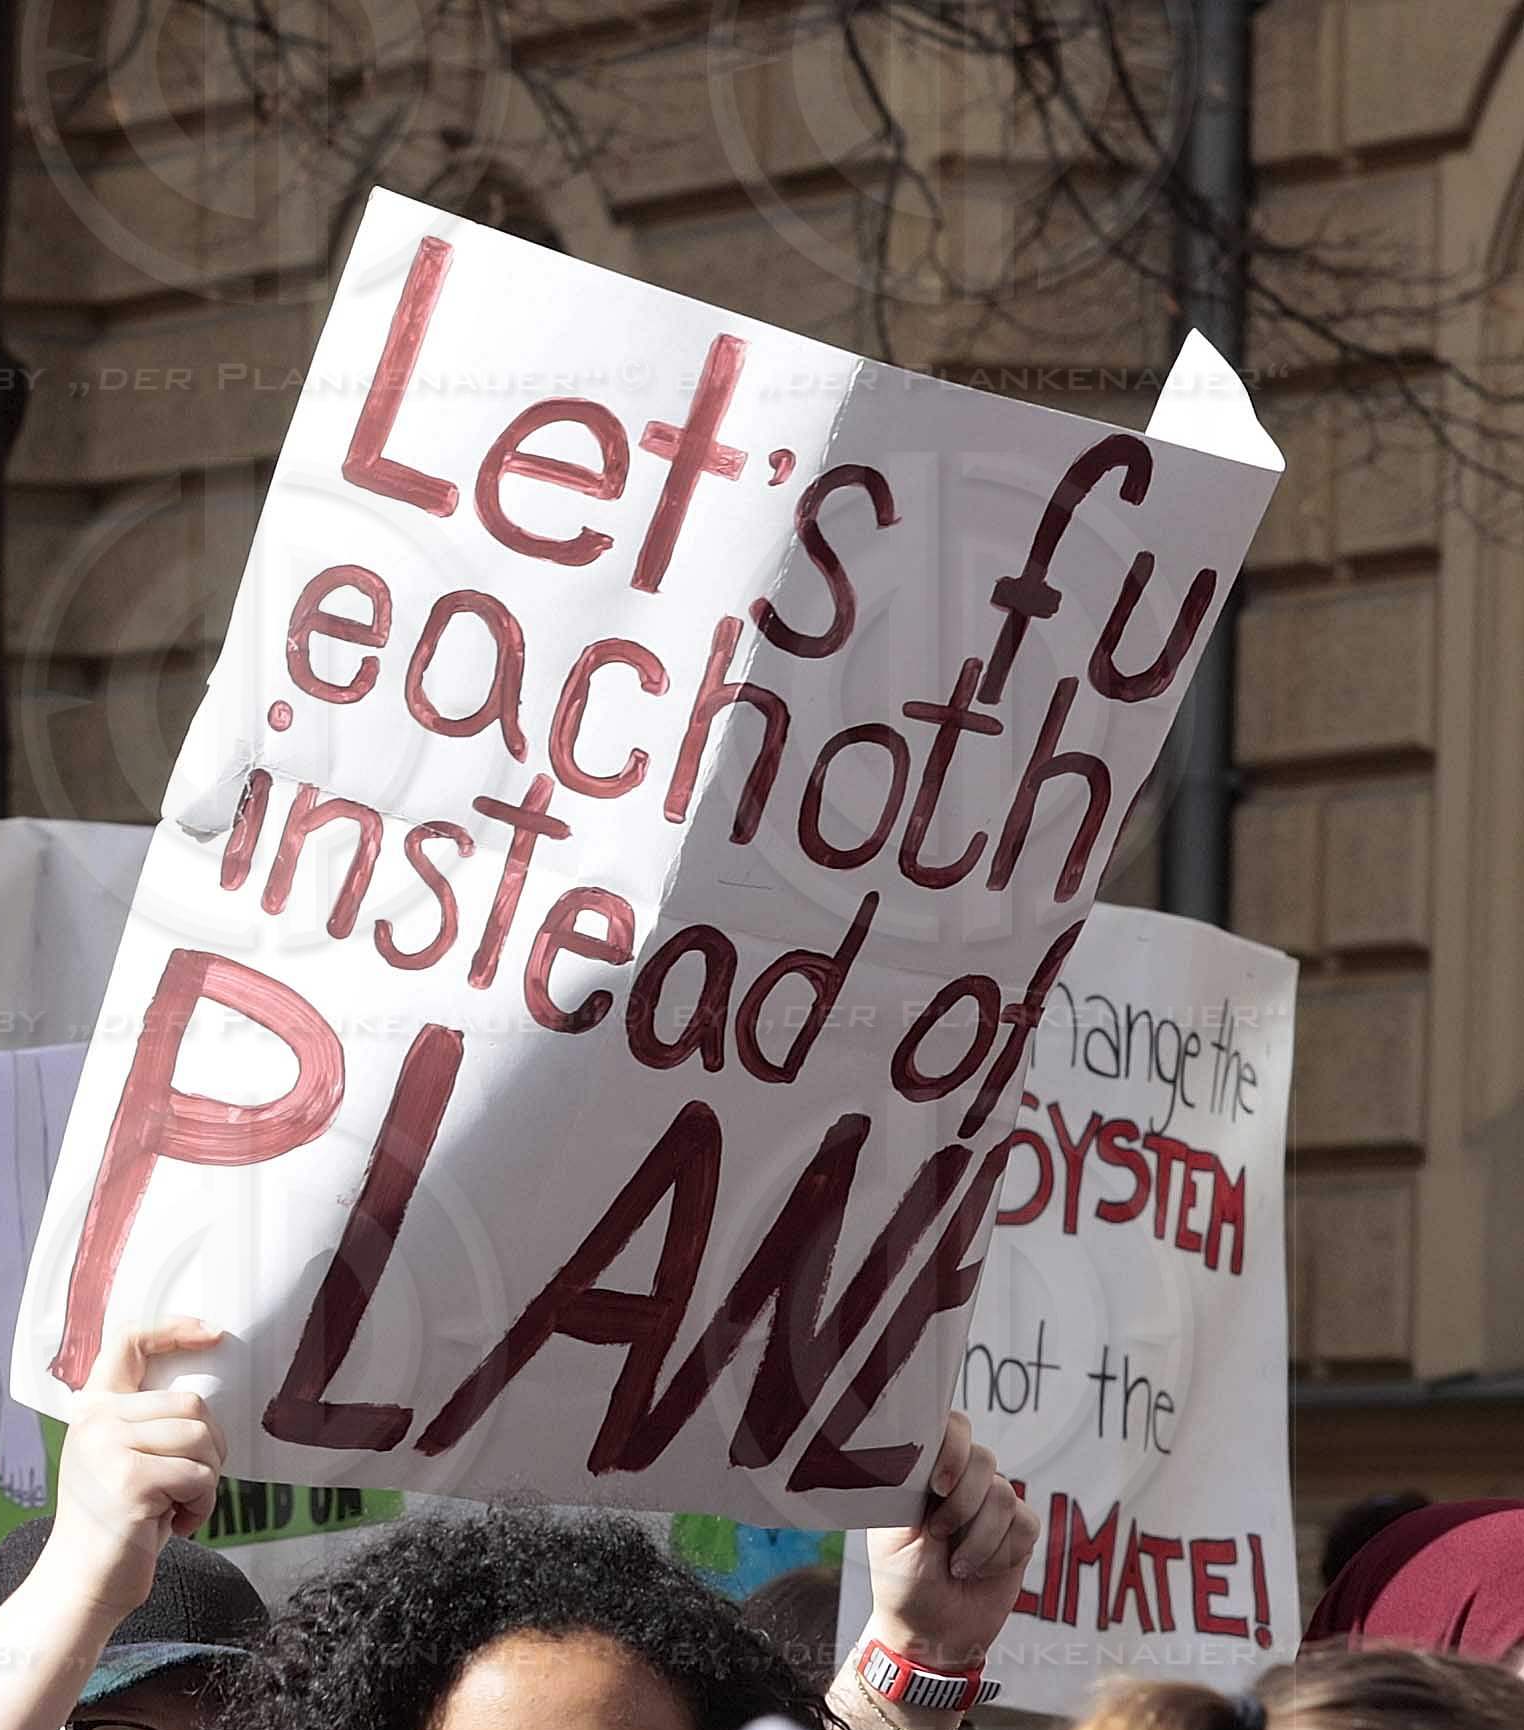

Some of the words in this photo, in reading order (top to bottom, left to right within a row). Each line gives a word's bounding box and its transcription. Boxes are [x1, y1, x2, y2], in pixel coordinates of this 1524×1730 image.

[341, 236, 896, 657] Let's
[218, 698, 880, 1084] instead
[1209, 996, 1257, 1122] the
[964, 1318, 1062, 1414] not
[1088, 1344, 1177, 1455] the
